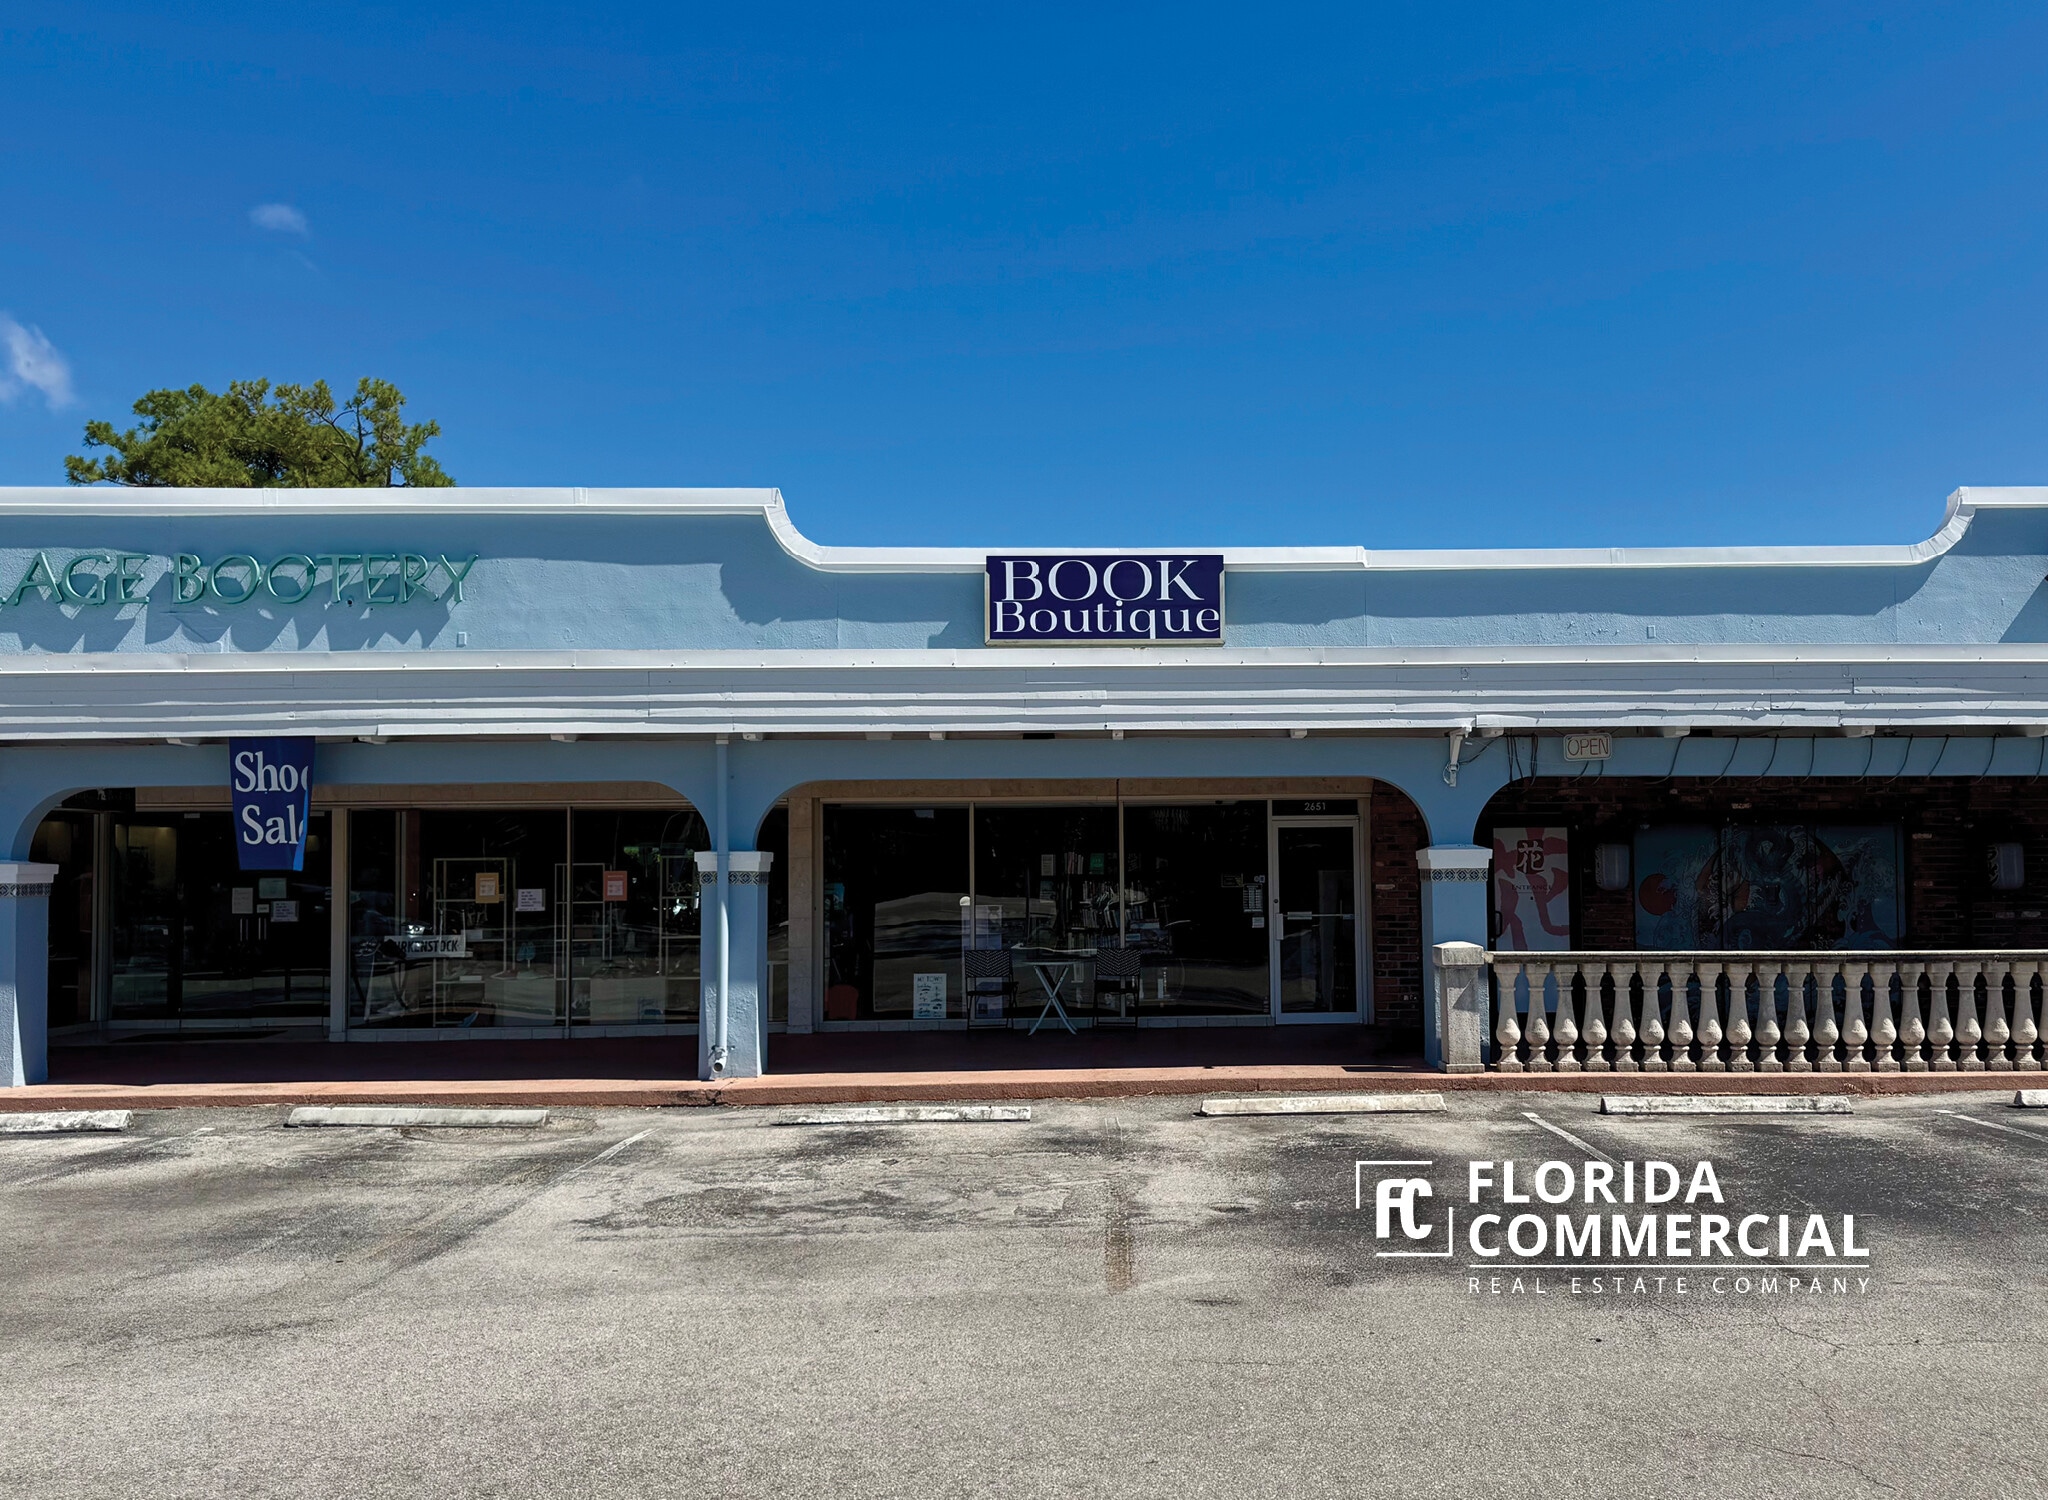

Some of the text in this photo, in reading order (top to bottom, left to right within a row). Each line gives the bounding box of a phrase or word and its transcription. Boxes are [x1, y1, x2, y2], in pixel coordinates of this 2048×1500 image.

[0, 552, 479, 606] AGE BOOTERY
[1000, 559, 1205, 602] BOOK
[993, 599, 1220, 640] Boutique
[1568, 738, 1609, 757] OPEN
[1304, 801, 1326, 811] 2651
